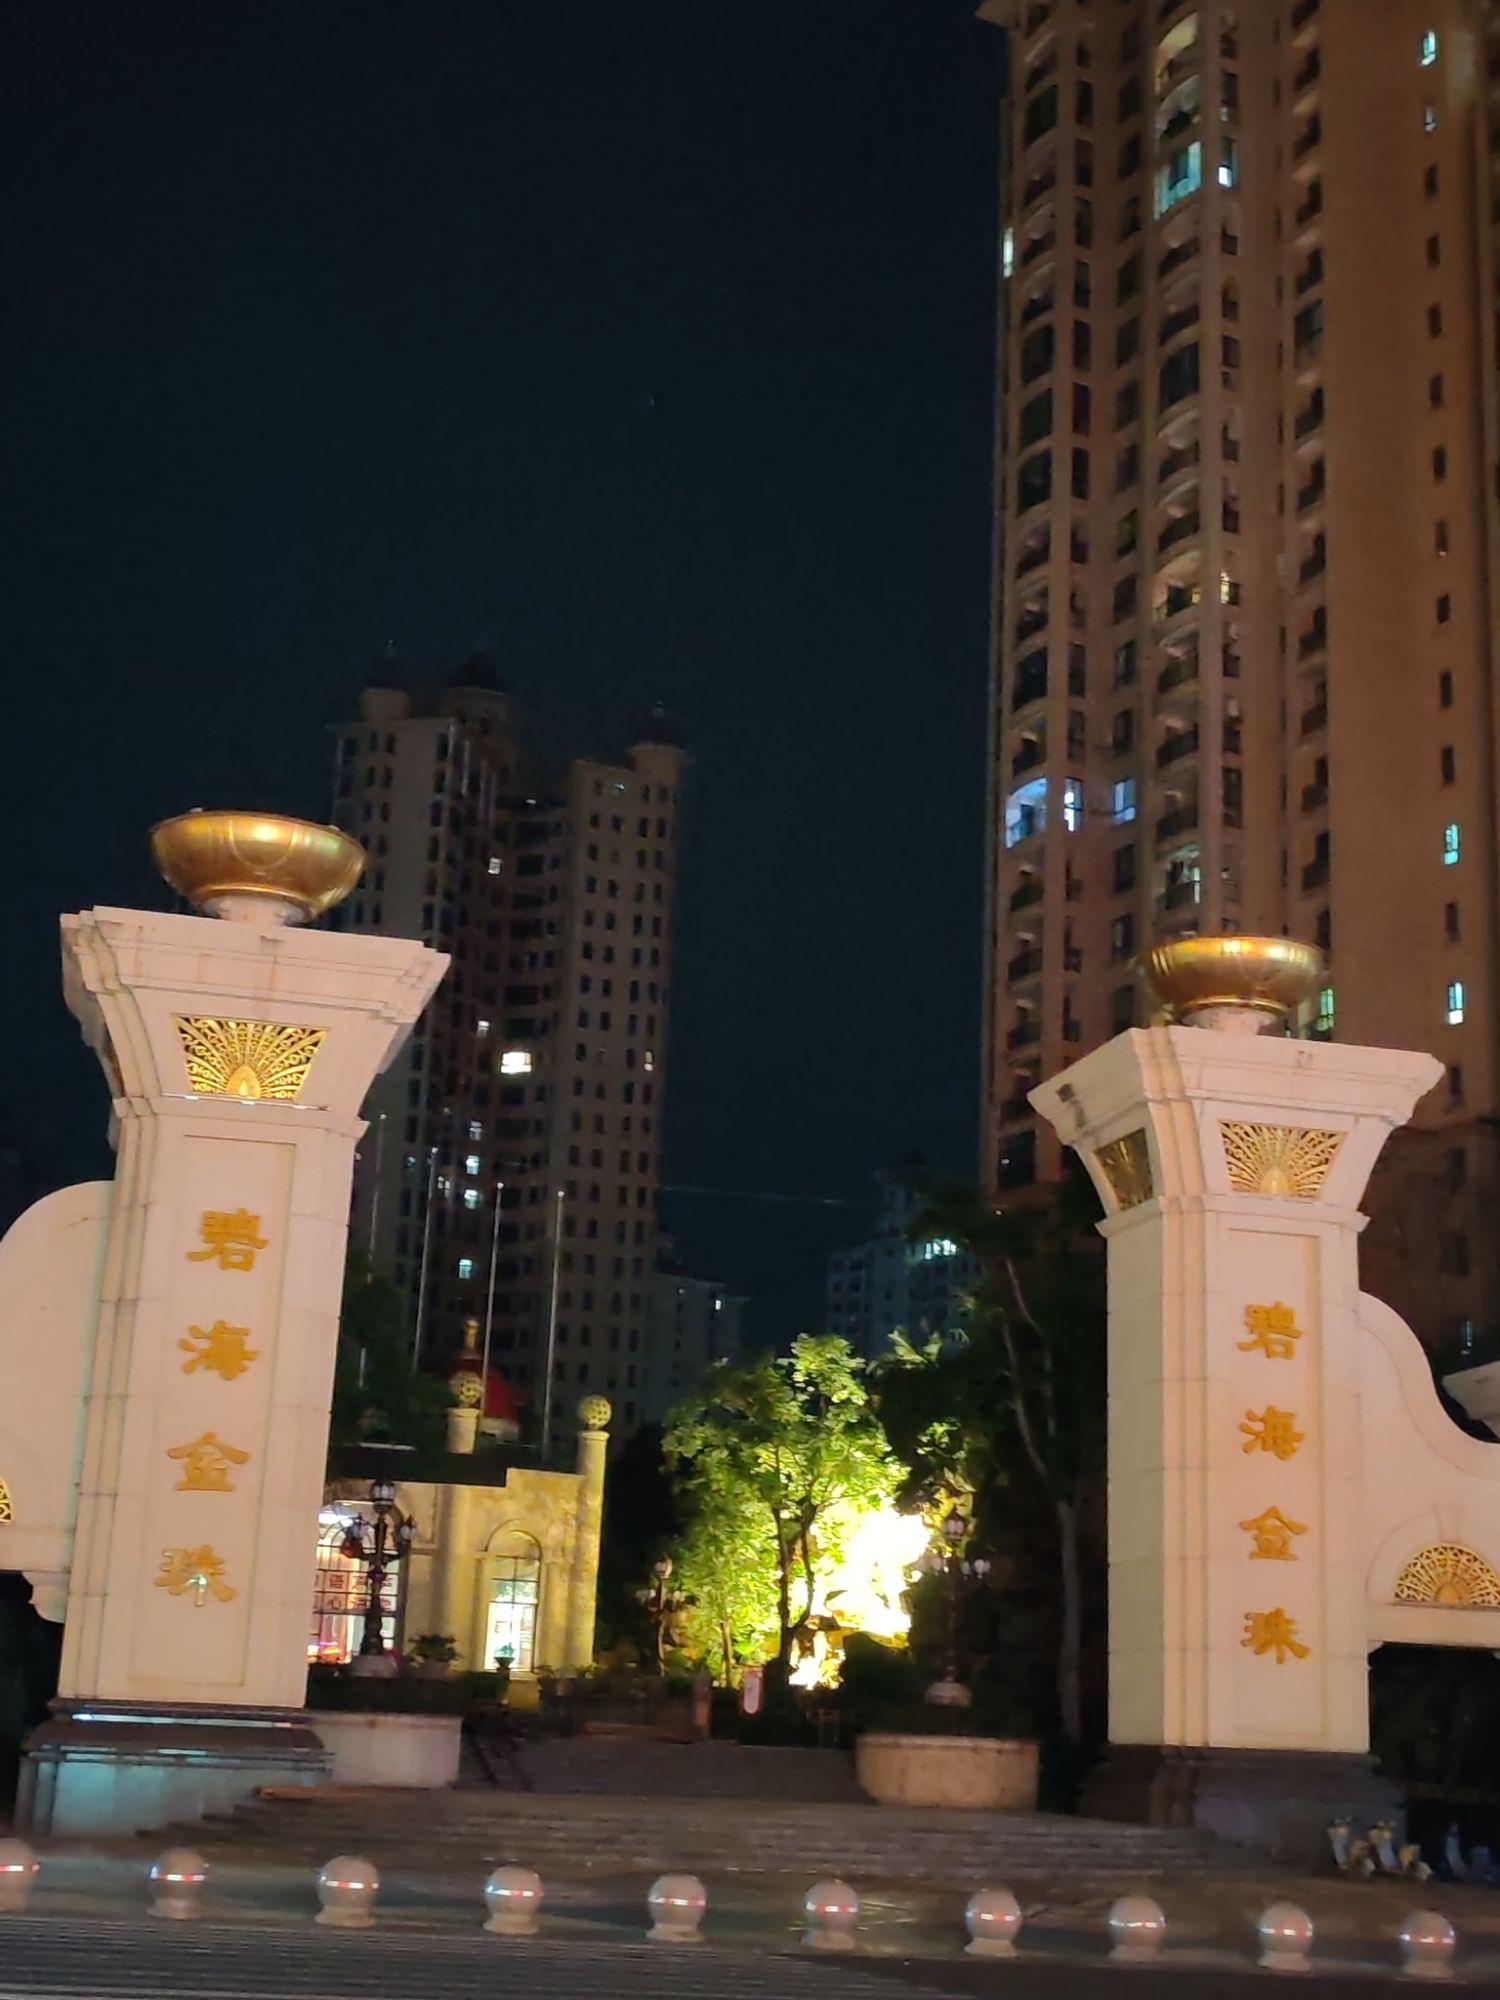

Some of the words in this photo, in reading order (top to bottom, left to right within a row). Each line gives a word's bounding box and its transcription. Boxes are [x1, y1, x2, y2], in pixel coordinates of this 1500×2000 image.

[154, 1207, 270, 1607] 碧海金珠
[1236, 1300, 1312, 1665] 碧海金珠
